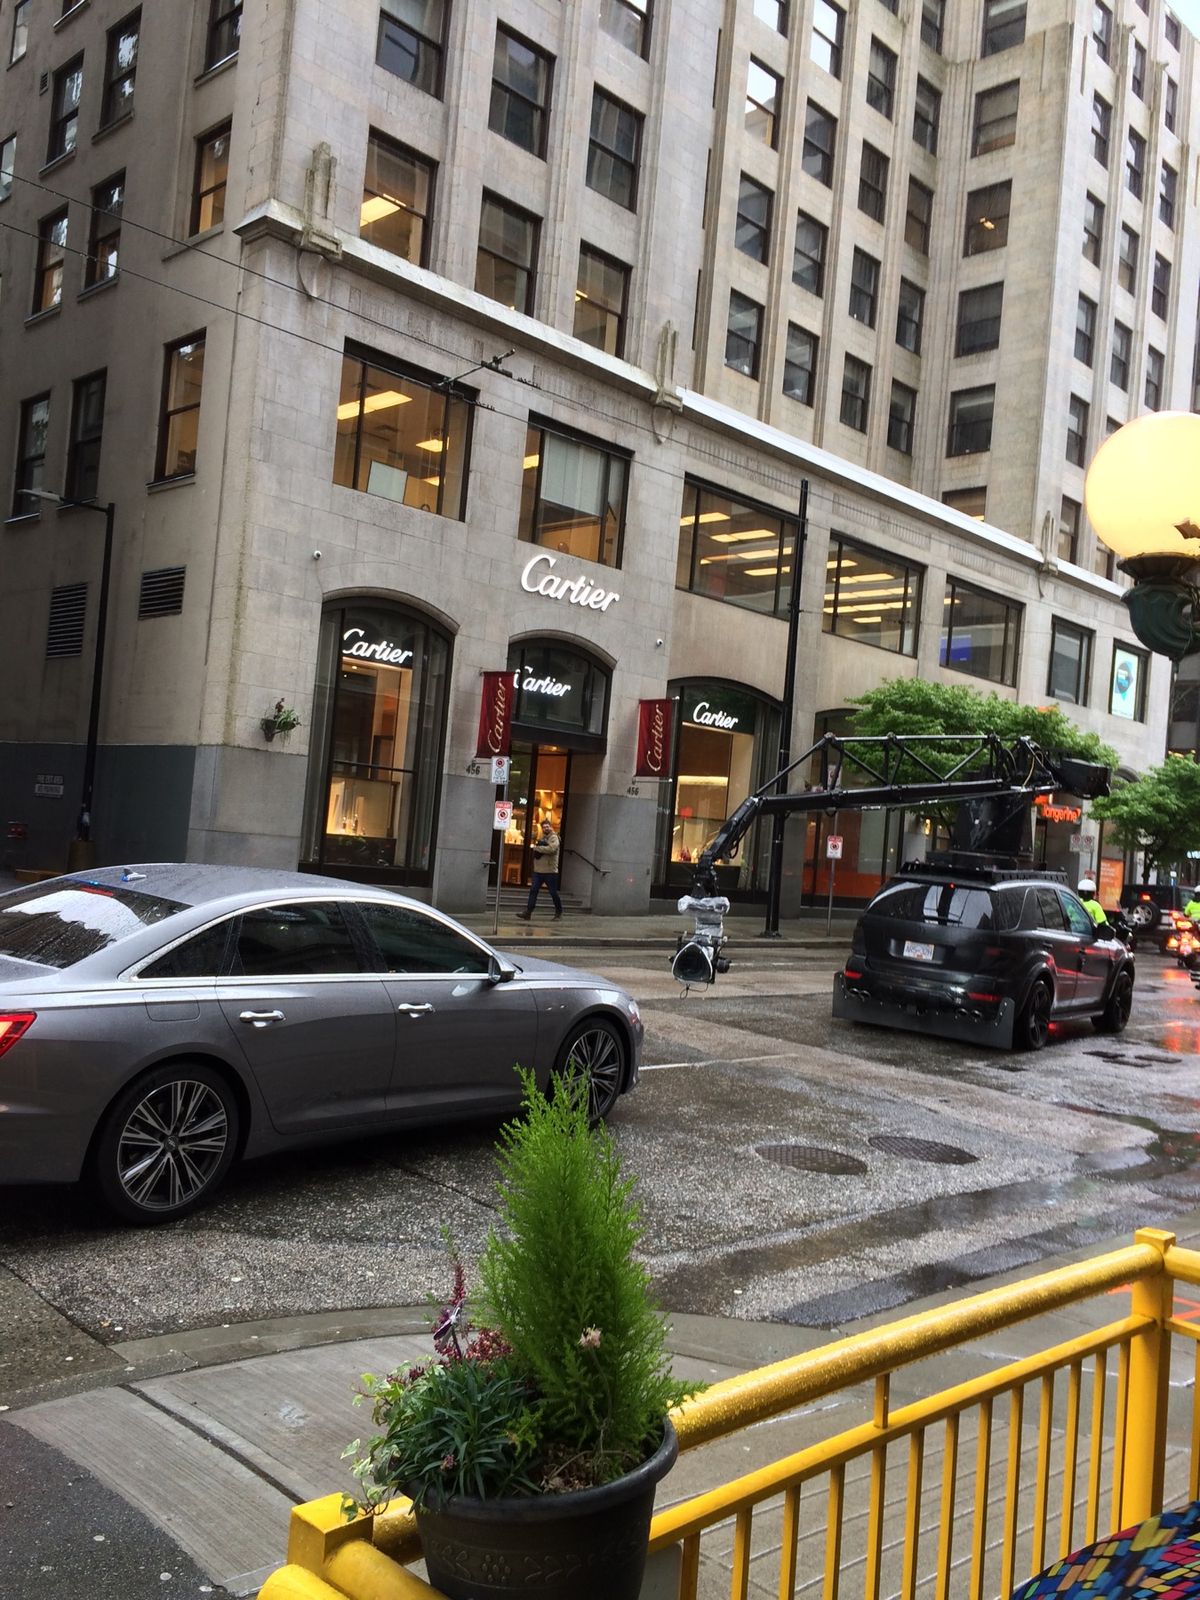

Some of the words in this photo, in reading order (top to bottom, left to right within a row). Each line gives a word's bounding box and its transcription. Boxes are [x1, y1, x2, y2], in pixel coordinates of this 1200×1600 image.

[521, 554, 620, 612] Cartier
[342, 628, 413, 664] Cartier
[487, 677, 506, 753] Cartier
[647, 704, 664, 772] Cartier
[693, 702, 739, 729] Cartier
[466, 764, 481, 775] 456
